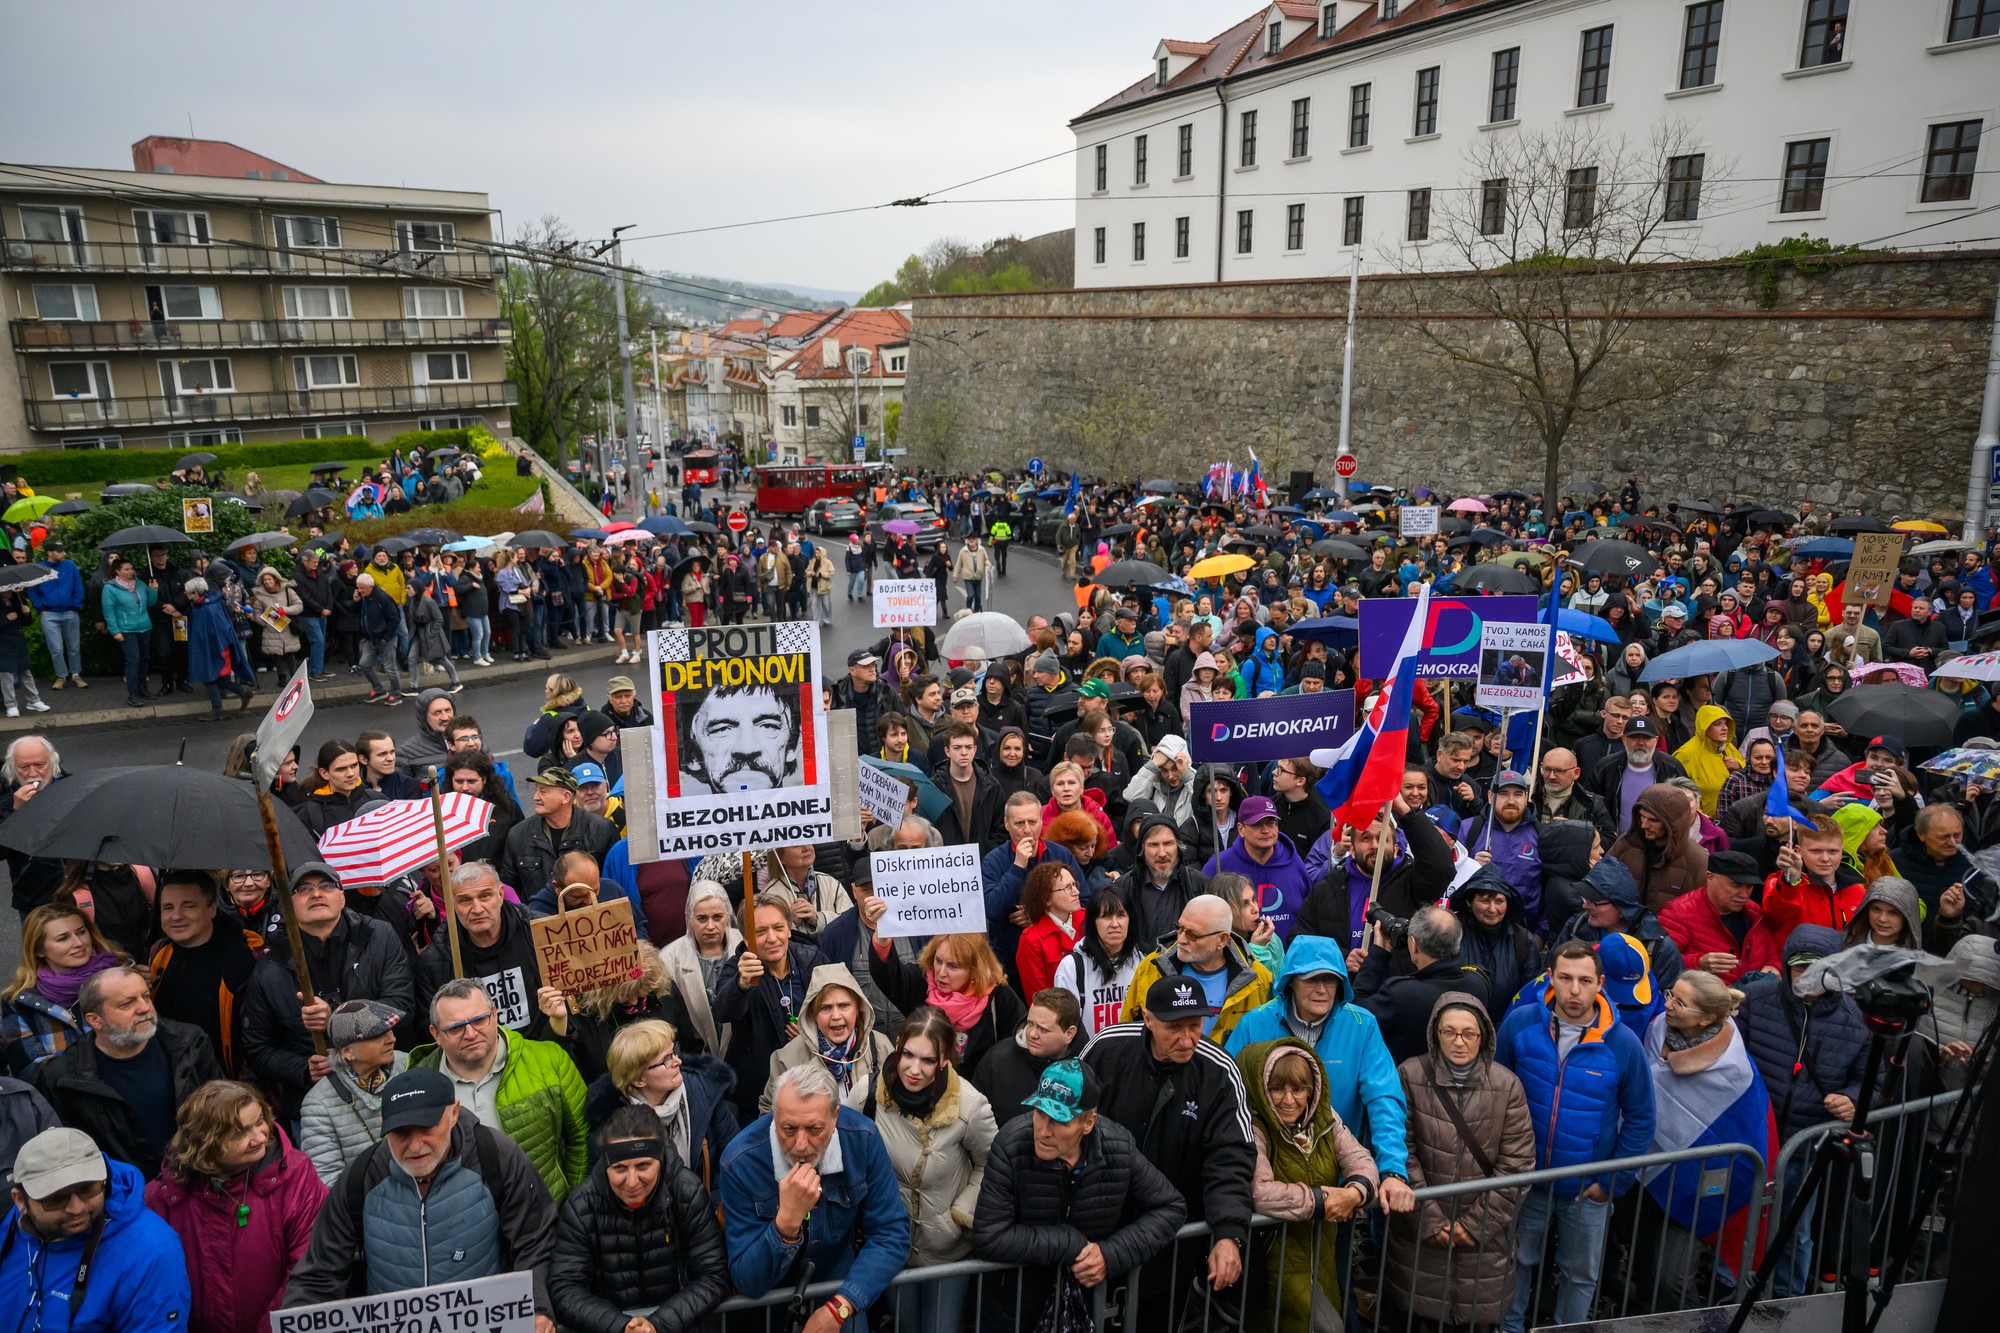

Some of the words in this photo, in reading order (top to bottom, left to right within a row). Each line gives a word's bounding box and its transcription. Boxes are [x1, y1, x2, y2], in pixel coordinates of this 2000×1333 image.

[1336, 461, 1356, 470] STOP
[688, 624, 777, 659] PROTI
[1485, 626, 1510, 635] TVOJ
[1515, 627, 1547, 637] KAMOŠ
[1484, 637, 1496, 646] ŤA
[1502, 637, 1514, 647] UŽ
[1520, 639, 1545, 649] ČAKÁ
[665, 653, 805, 692] DÉMONOVI
[1415, 663, 1479, 675] EMOKRA
[1480, 687, 1538, 698] NEZDRŽUJ!
[1232, 715, 1338, 739] DEMOKRATI
[861, 766, 871, 779] OD
[859, 781, 874, 797] AKÁM
[665, 797, 831, 829] BEZOHĽADNEJ
[876, 852, 974, 873] Diskriminácia
[877, 883, 899, 898] nie
[902, 881, 915, 900] je
[919, 875, 979, 895] volebná
[897, 903, 963, 921] reforma!
[544, 910, 620, 945] MOC
[541, 930, 601, 963] PATRÍ
[548, 960, 570, 976] NIE
[548, 950, 639, 988] FICOREŽIMU!
[481, 972, 516, 998] OSŤ
[561, 985, 580, 996] EZMÚ
[1172, 998, 1197, 1007] adidas
[497, 1005, 523, 1026] CA!
[1093, 1002, 1122, 1034] FIC
[77, 1264, 87, 1282] EOS
[352, 1301, 390, 1324] VIKI
[394, 1288, 484, 1318] DOSTAL
[428, 1315, 442, 1333] A
[448, 1309, 478, 1330] TO
[485, 1294, 534, 1325] ISTÉ
